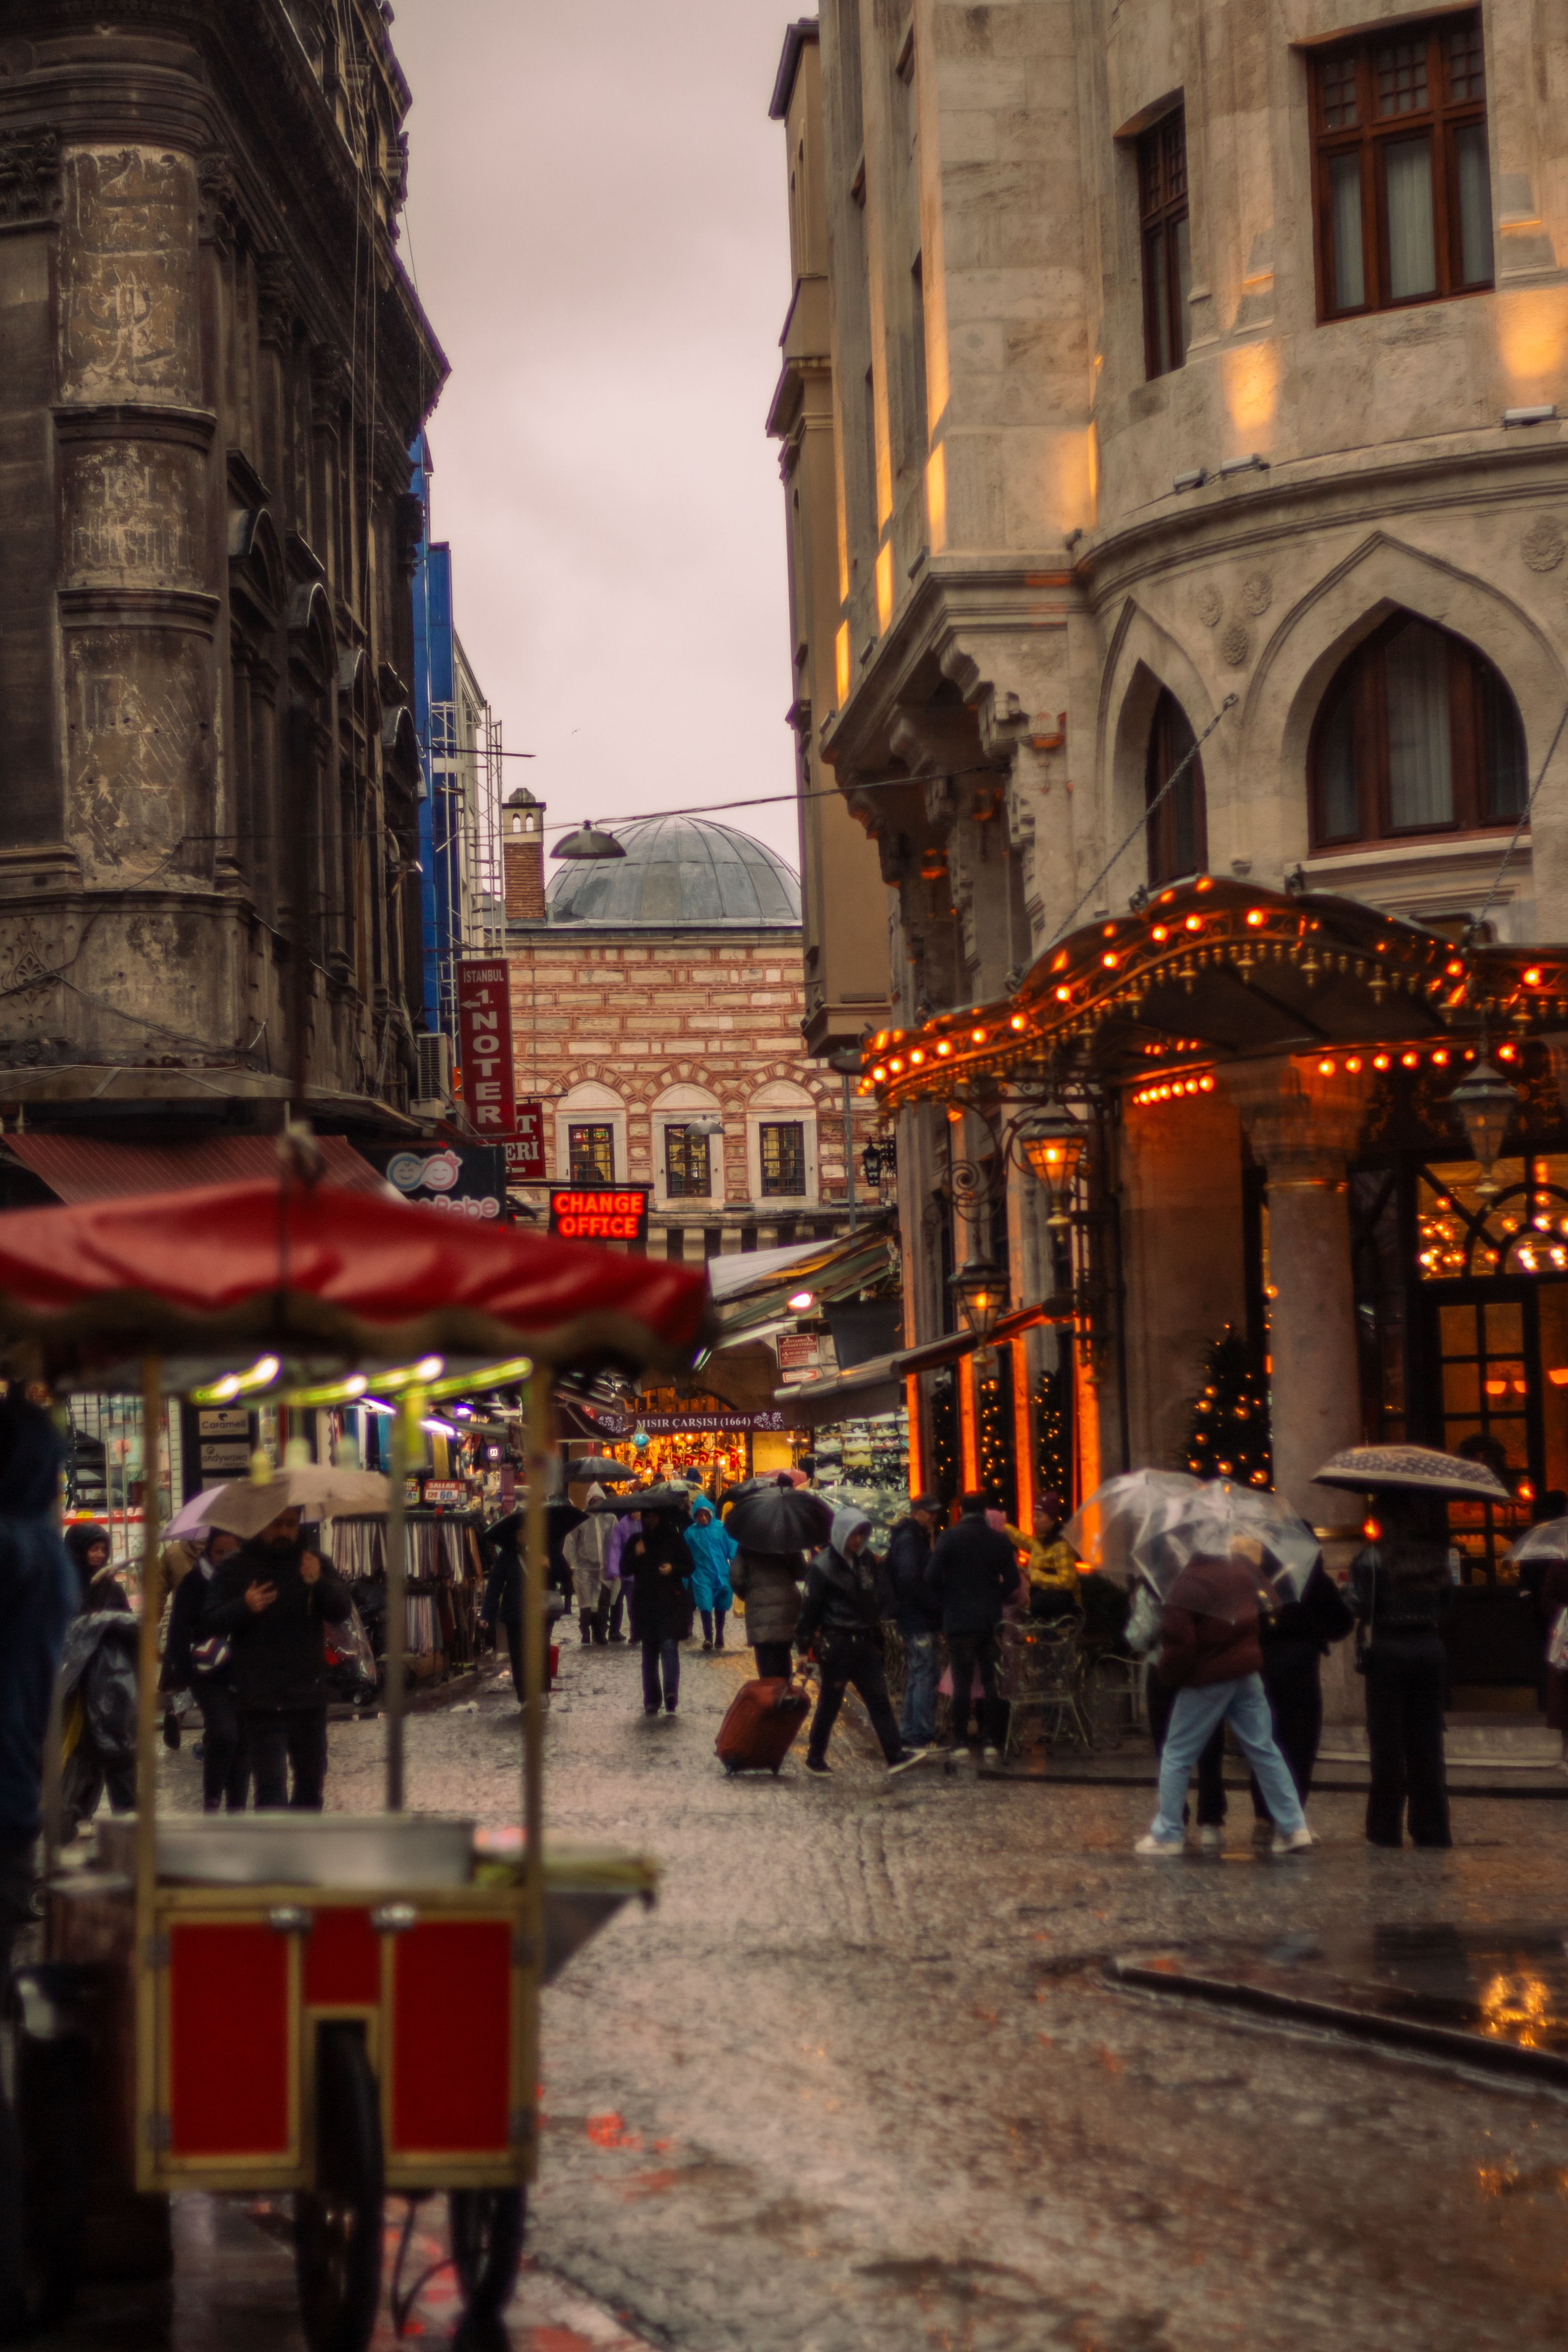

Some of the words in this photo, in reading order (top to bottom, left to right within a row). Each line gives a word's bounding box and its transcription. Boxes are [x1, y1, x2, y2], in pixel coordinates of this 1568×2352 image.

[463, 968, 504, 983] İSTANBUL
[475, 989, 493, 1004] 1.
[472, 1011, 502, 1124] NOTER
[502, 1135, 539, 1161] ERİ
[554, 1193, 643, 1214] CHANGE
[559, 1216, 637, 1238] OFFICE
[637, 1419, 669, 1428] MISIR
[672, 1418, 717, 1429] ÇARŞISI
[720, 1417, 751, 1427] (1664)
